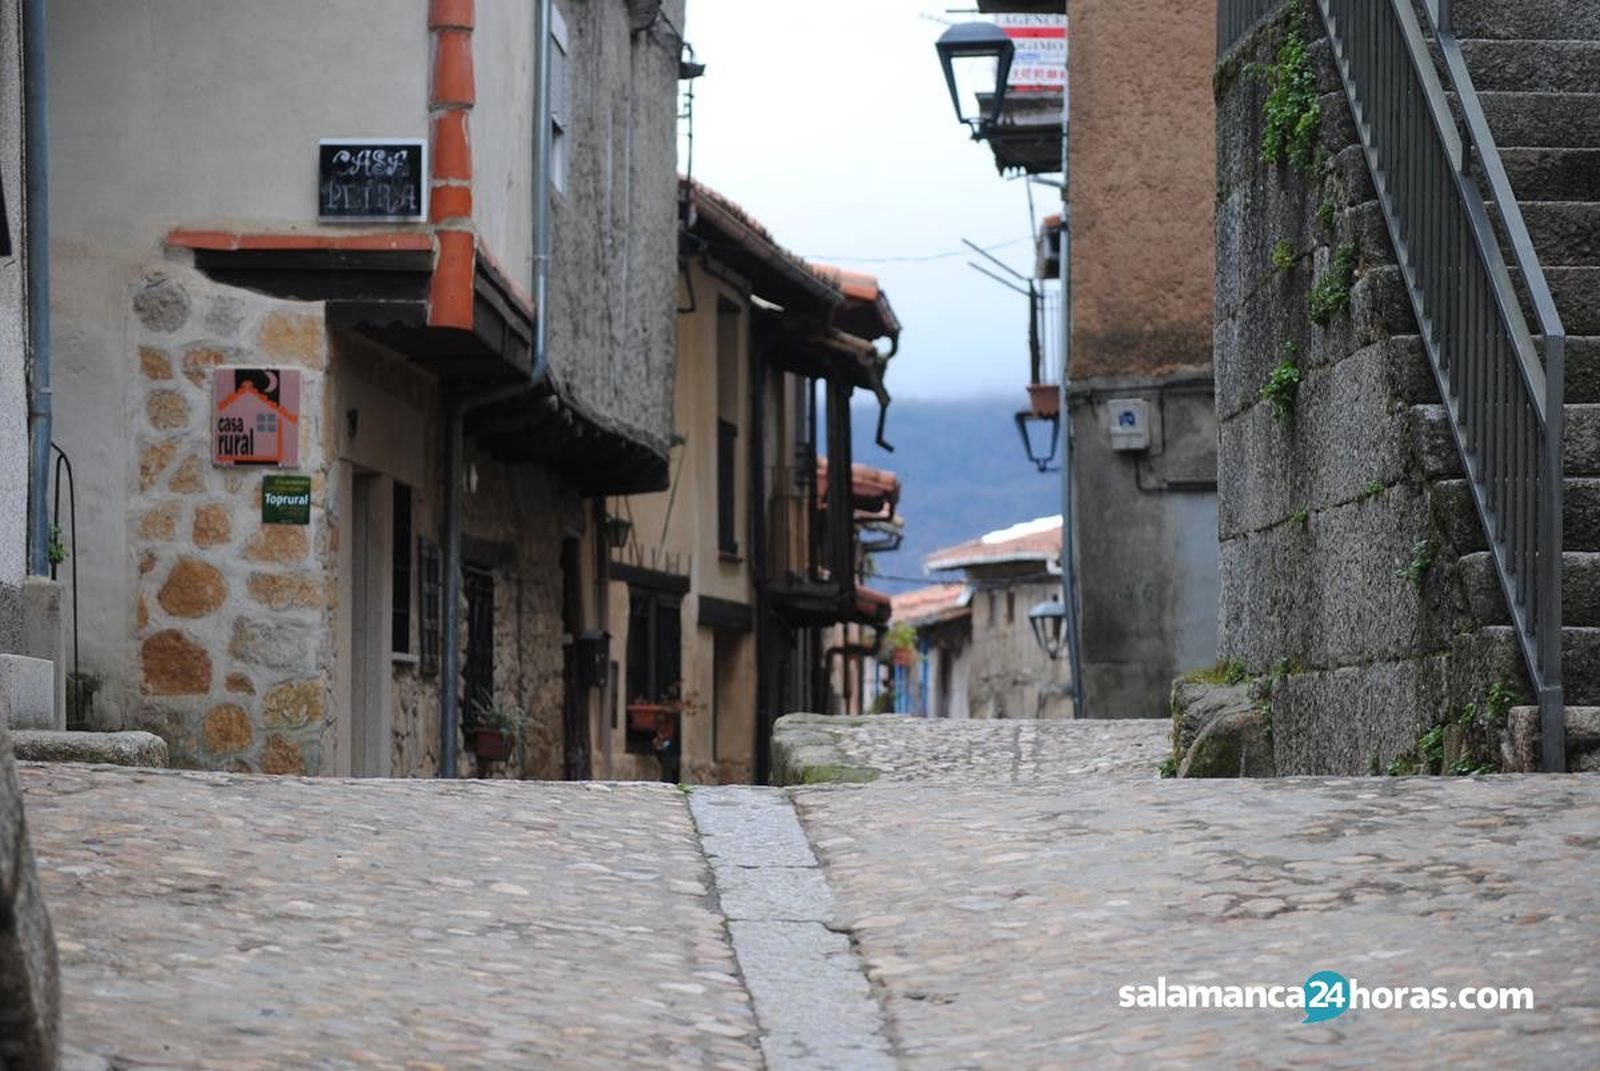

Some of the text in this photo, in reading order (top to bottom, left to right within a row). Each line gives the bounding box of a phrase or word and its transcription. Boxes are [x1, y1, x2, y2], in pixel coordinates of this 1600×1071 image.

[218, 416, 243, 432] casa
[218, 428, 254, 455] rural
[265, 493, 309, 507] Toprural
